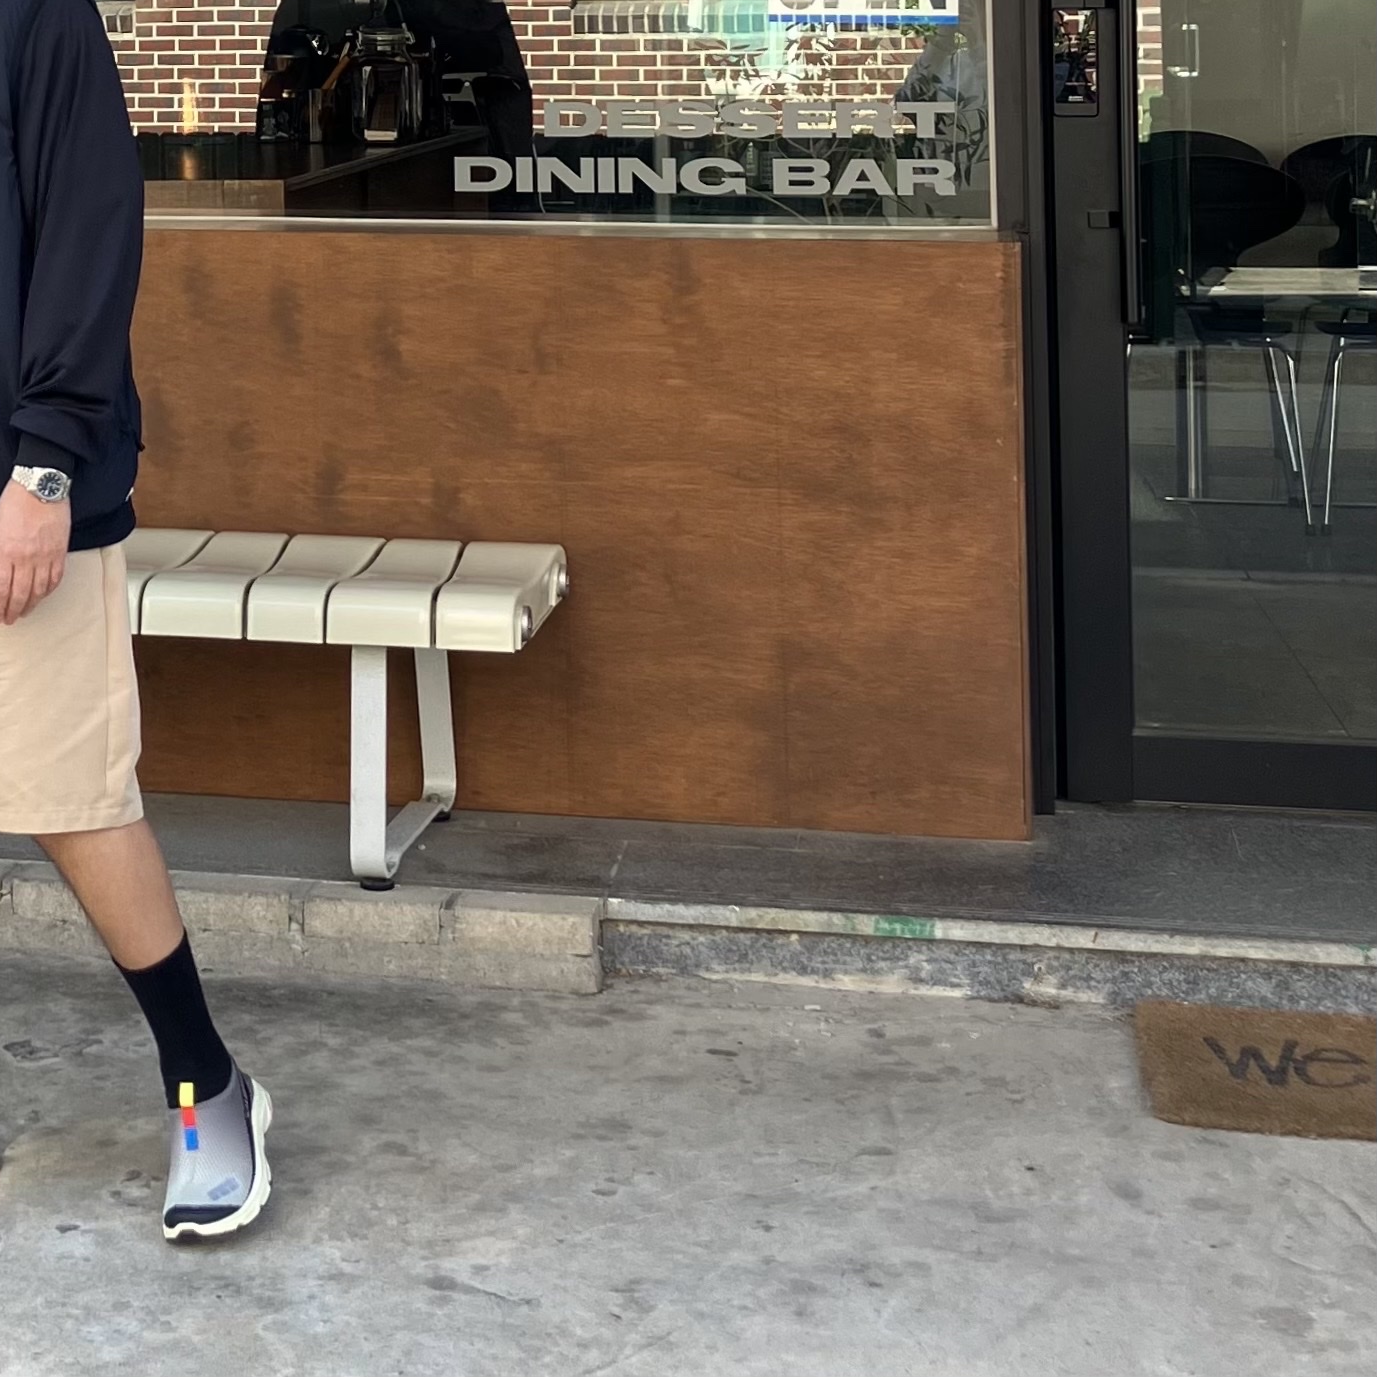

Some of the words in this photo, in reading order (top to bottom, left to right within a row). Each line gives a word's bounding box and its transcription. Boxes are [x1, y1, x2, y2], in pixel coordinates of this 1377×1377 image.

[543, 101, 957, 139] DESSERT
[454, 155, 748, 196] DINING
[771, 157, 957, 197] BAR
